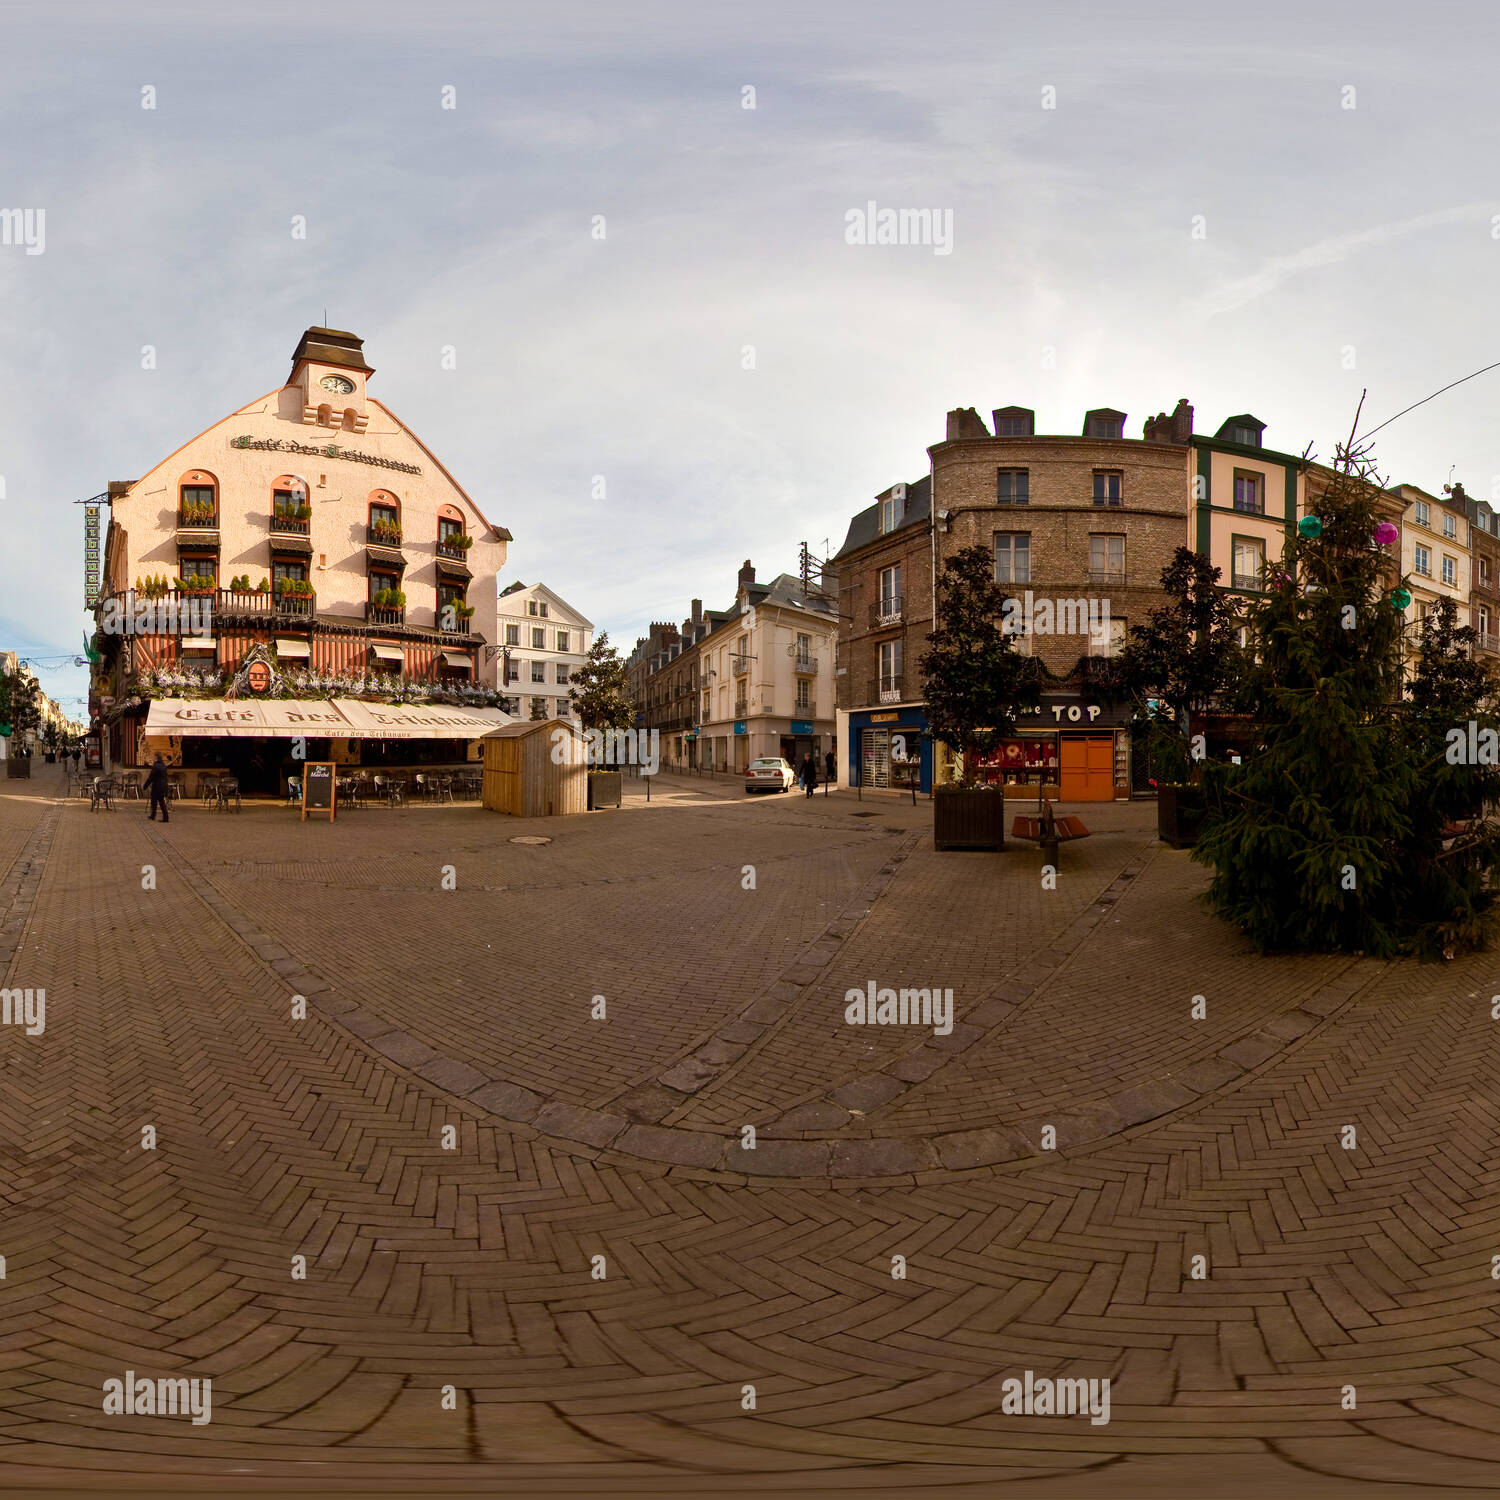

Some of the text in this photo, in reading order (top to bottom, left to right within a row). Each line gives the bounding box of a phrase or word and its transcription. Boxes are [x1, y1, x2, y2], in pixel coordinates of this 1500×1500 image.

[174, 708, 505, 727] Café des Tribunaux
[1051, 705, 1101, 721] TOP
